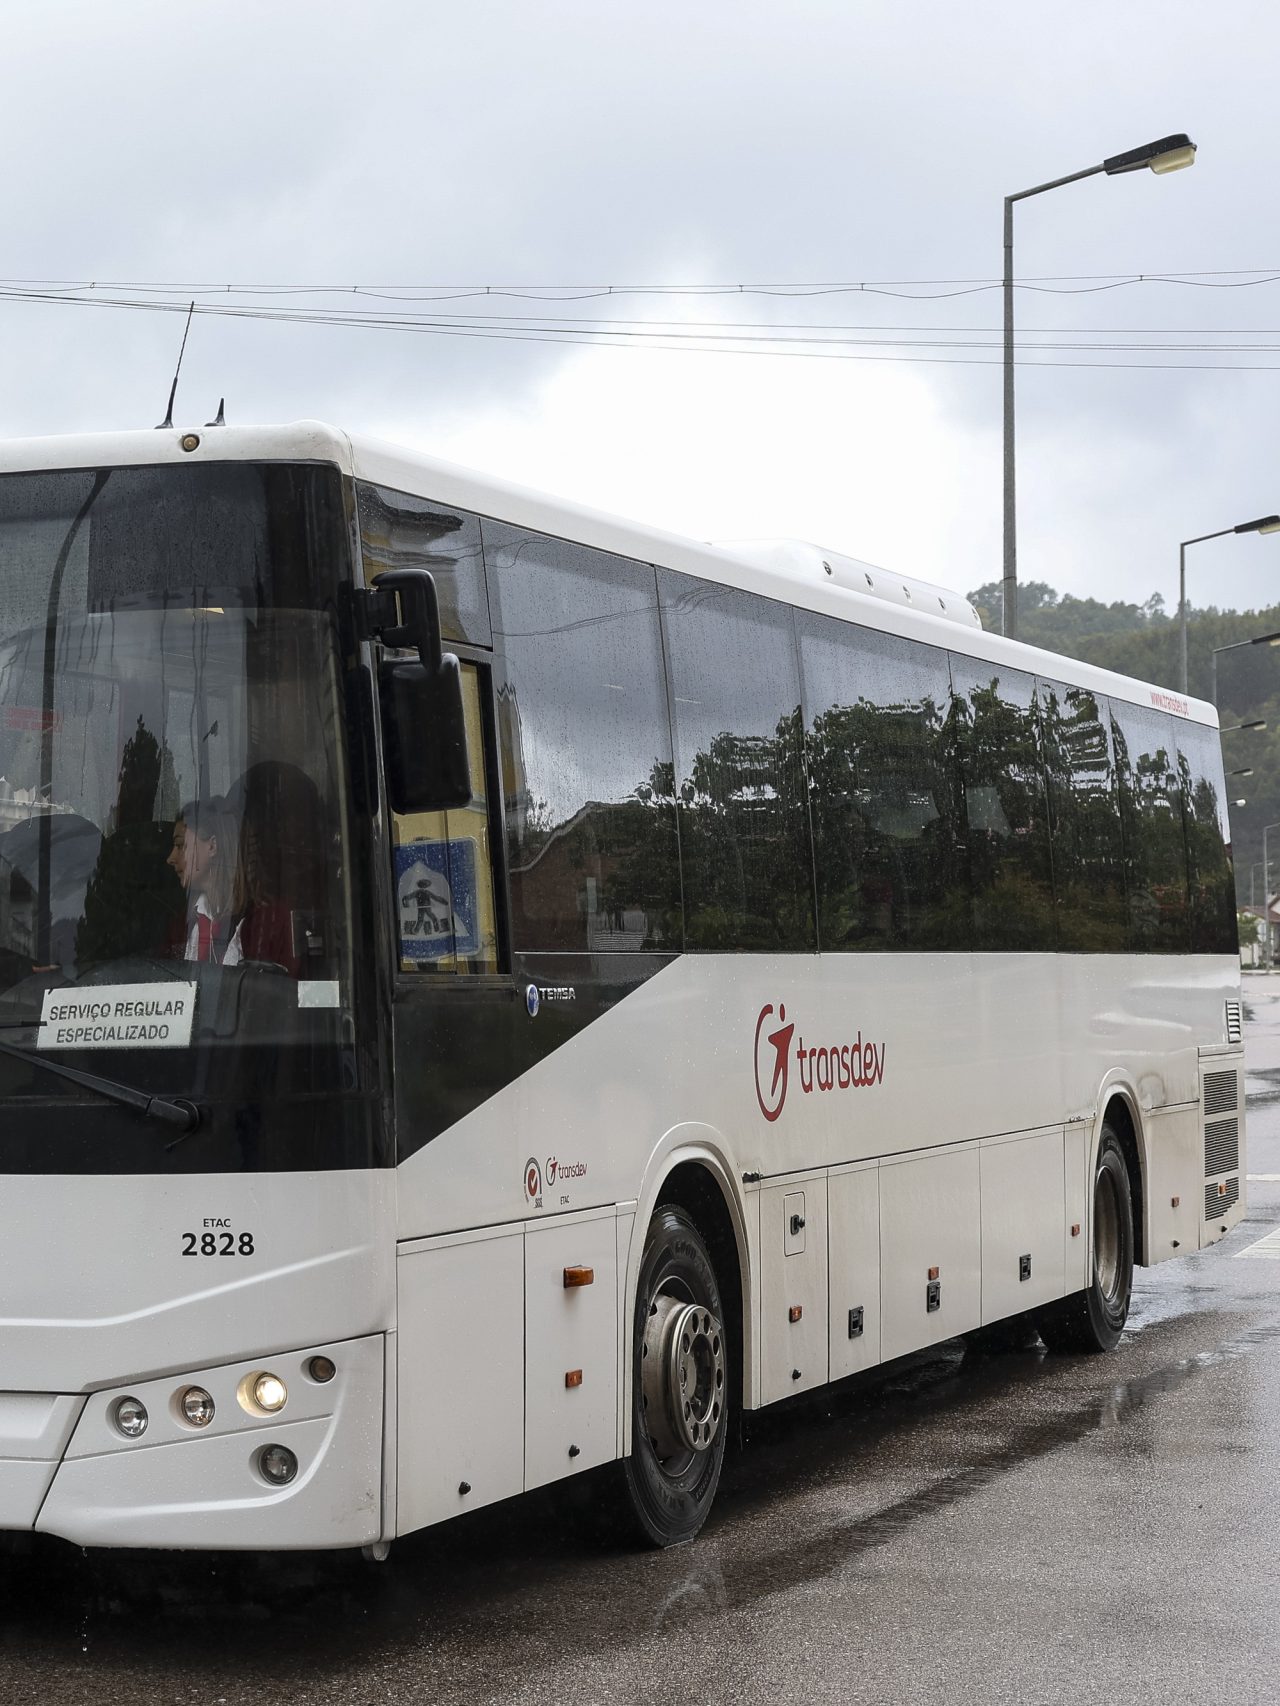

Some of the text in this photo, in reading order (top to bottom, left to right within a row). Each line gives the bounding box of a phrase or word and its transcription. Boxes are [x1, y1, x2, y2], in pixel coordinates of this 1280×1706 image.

[538, 987, 576, 1000] TEMSA
[49, 1000, 184, 1022] SERVIÇO REGULAR
[56, 1024, 170, 1043] ESPECIALIZADO
[796, 1030, 886, 1093] transdev
[558, 1161, 588, 1179] transdev
[203, 1218, 231, 1228] ETAC
[181, 1232, 255, 1256] 2828
